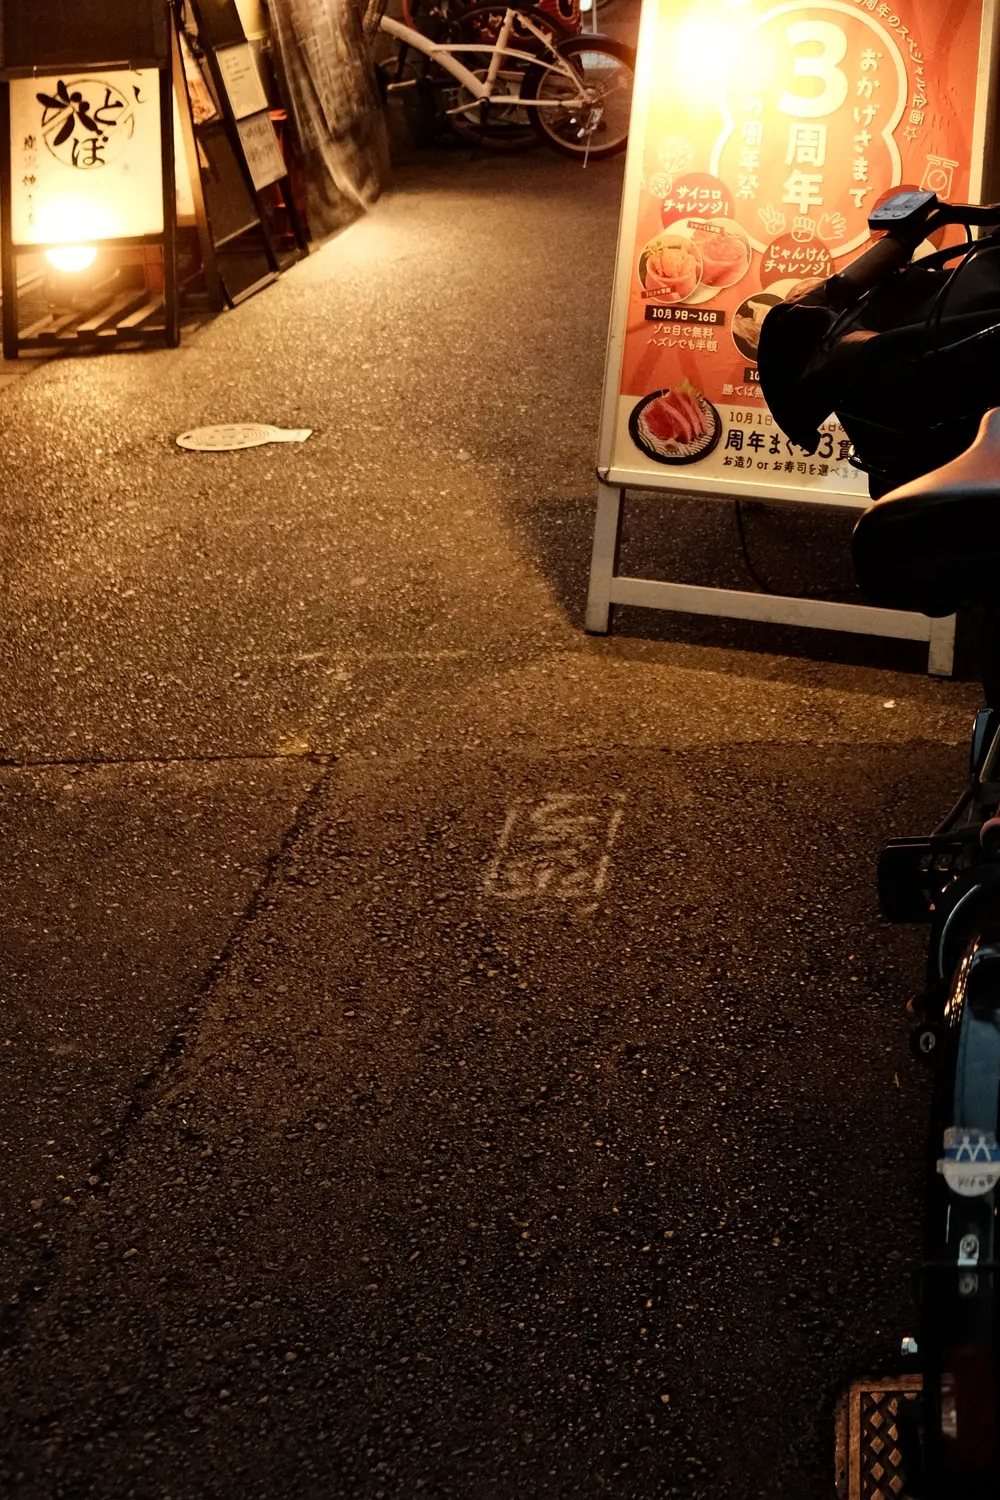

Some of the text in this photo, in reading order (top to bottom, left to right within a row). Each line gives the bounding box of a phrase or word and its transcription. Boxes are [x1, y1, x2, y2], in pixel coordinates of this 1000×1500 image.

[849, 47, 883, 209] おかげさまで
[676, 185, 722, 200] サイコロ
[663, 199, 729, 216] チャレンジ!
[769, 244, 830, 262] じゃんけん
[764, 260, 832, 276] チャレンジ!
[653, 324, 714, 339] ゾロ目で無料
[646, 338, 718, 353] ハズレでも半額
[722, 455, 860, 480] お造り or お寿司を選べます
